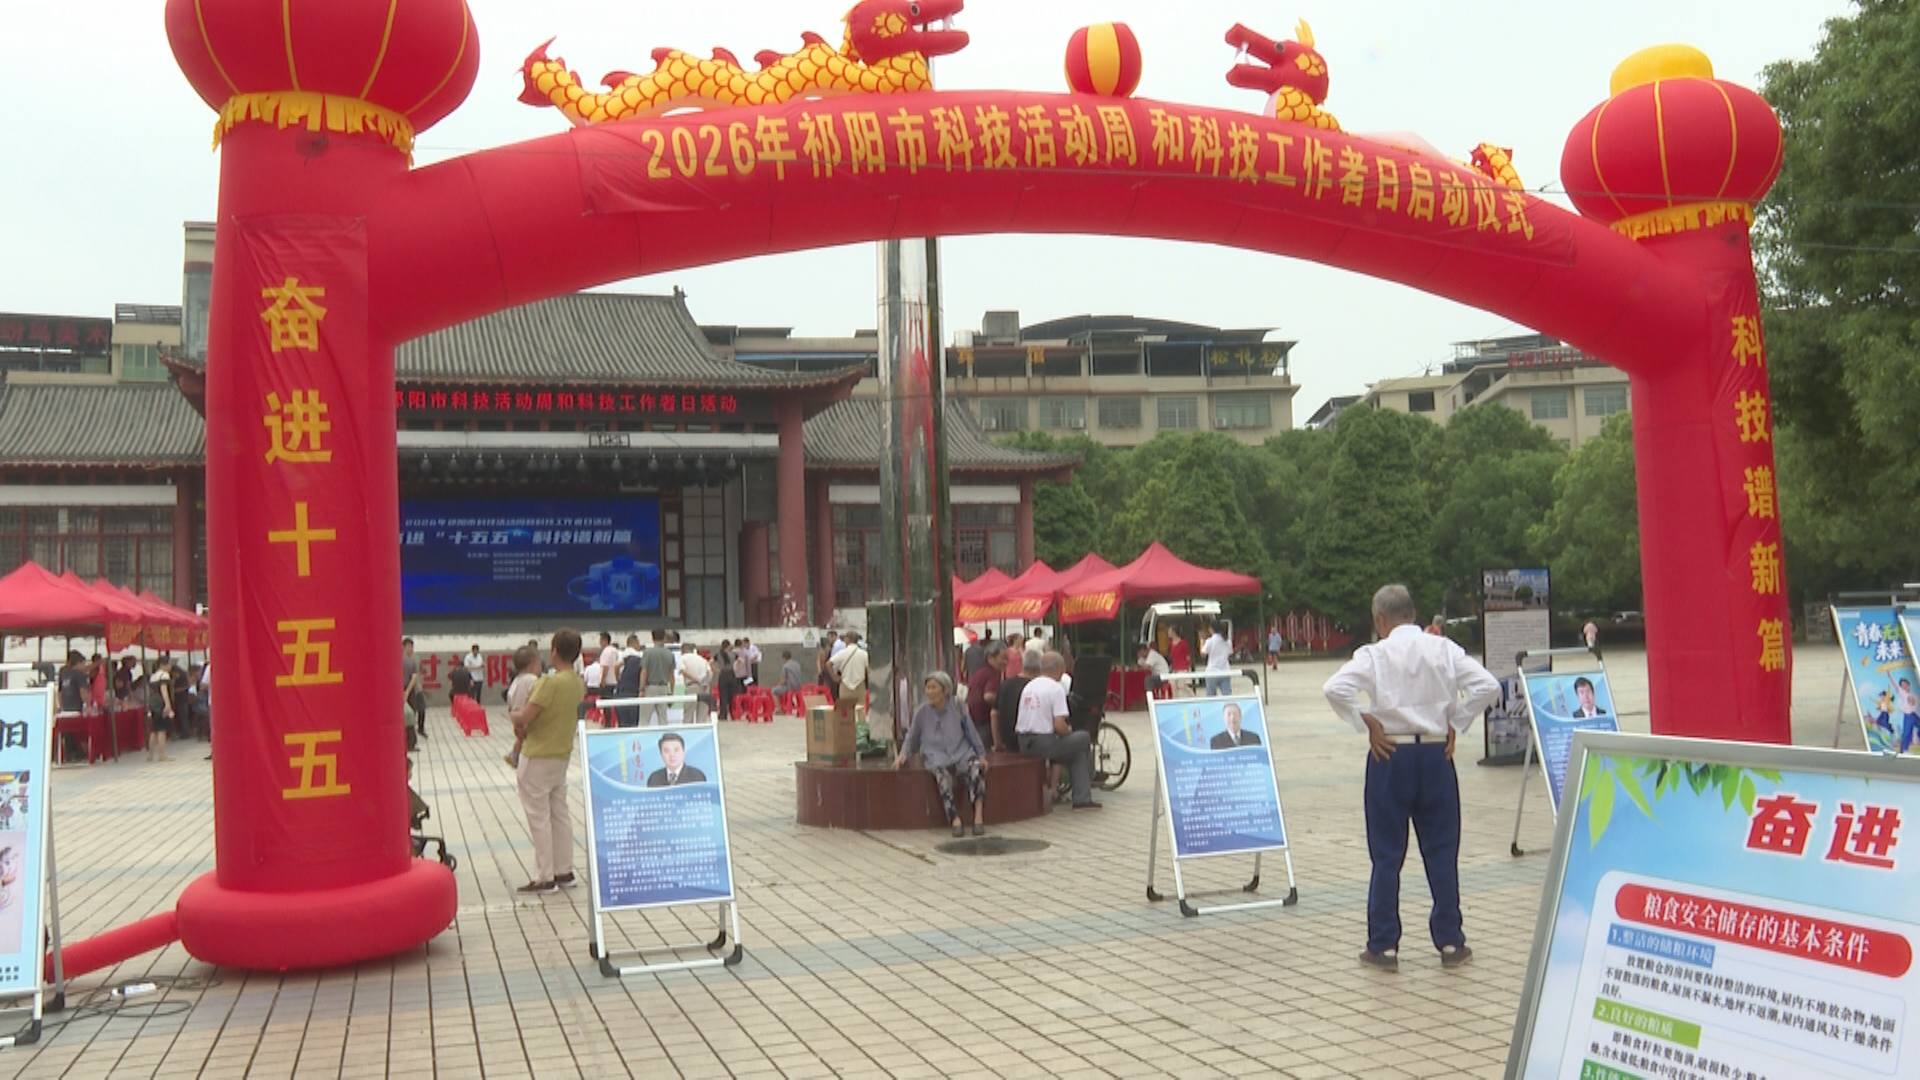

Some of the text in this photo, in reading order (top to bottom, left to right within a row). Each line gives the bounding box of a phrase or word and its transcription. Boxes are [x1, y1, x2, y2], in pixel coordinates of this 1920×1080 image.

[641, 104, 1535, 241] 2026年祁阳市科技活动周 和科技工作者日启动仪式
[260, 277, 352, 800] 奋进十五五
[400, 529, 632, 545] 进“十五五”科技谱新篇
[1731, 314, 1786, 673] 科技谱新篇
[1746, 793, 1902, 871] 奋进
[1643, 891, 1870, 964] 粮食安全储存的基本条件
